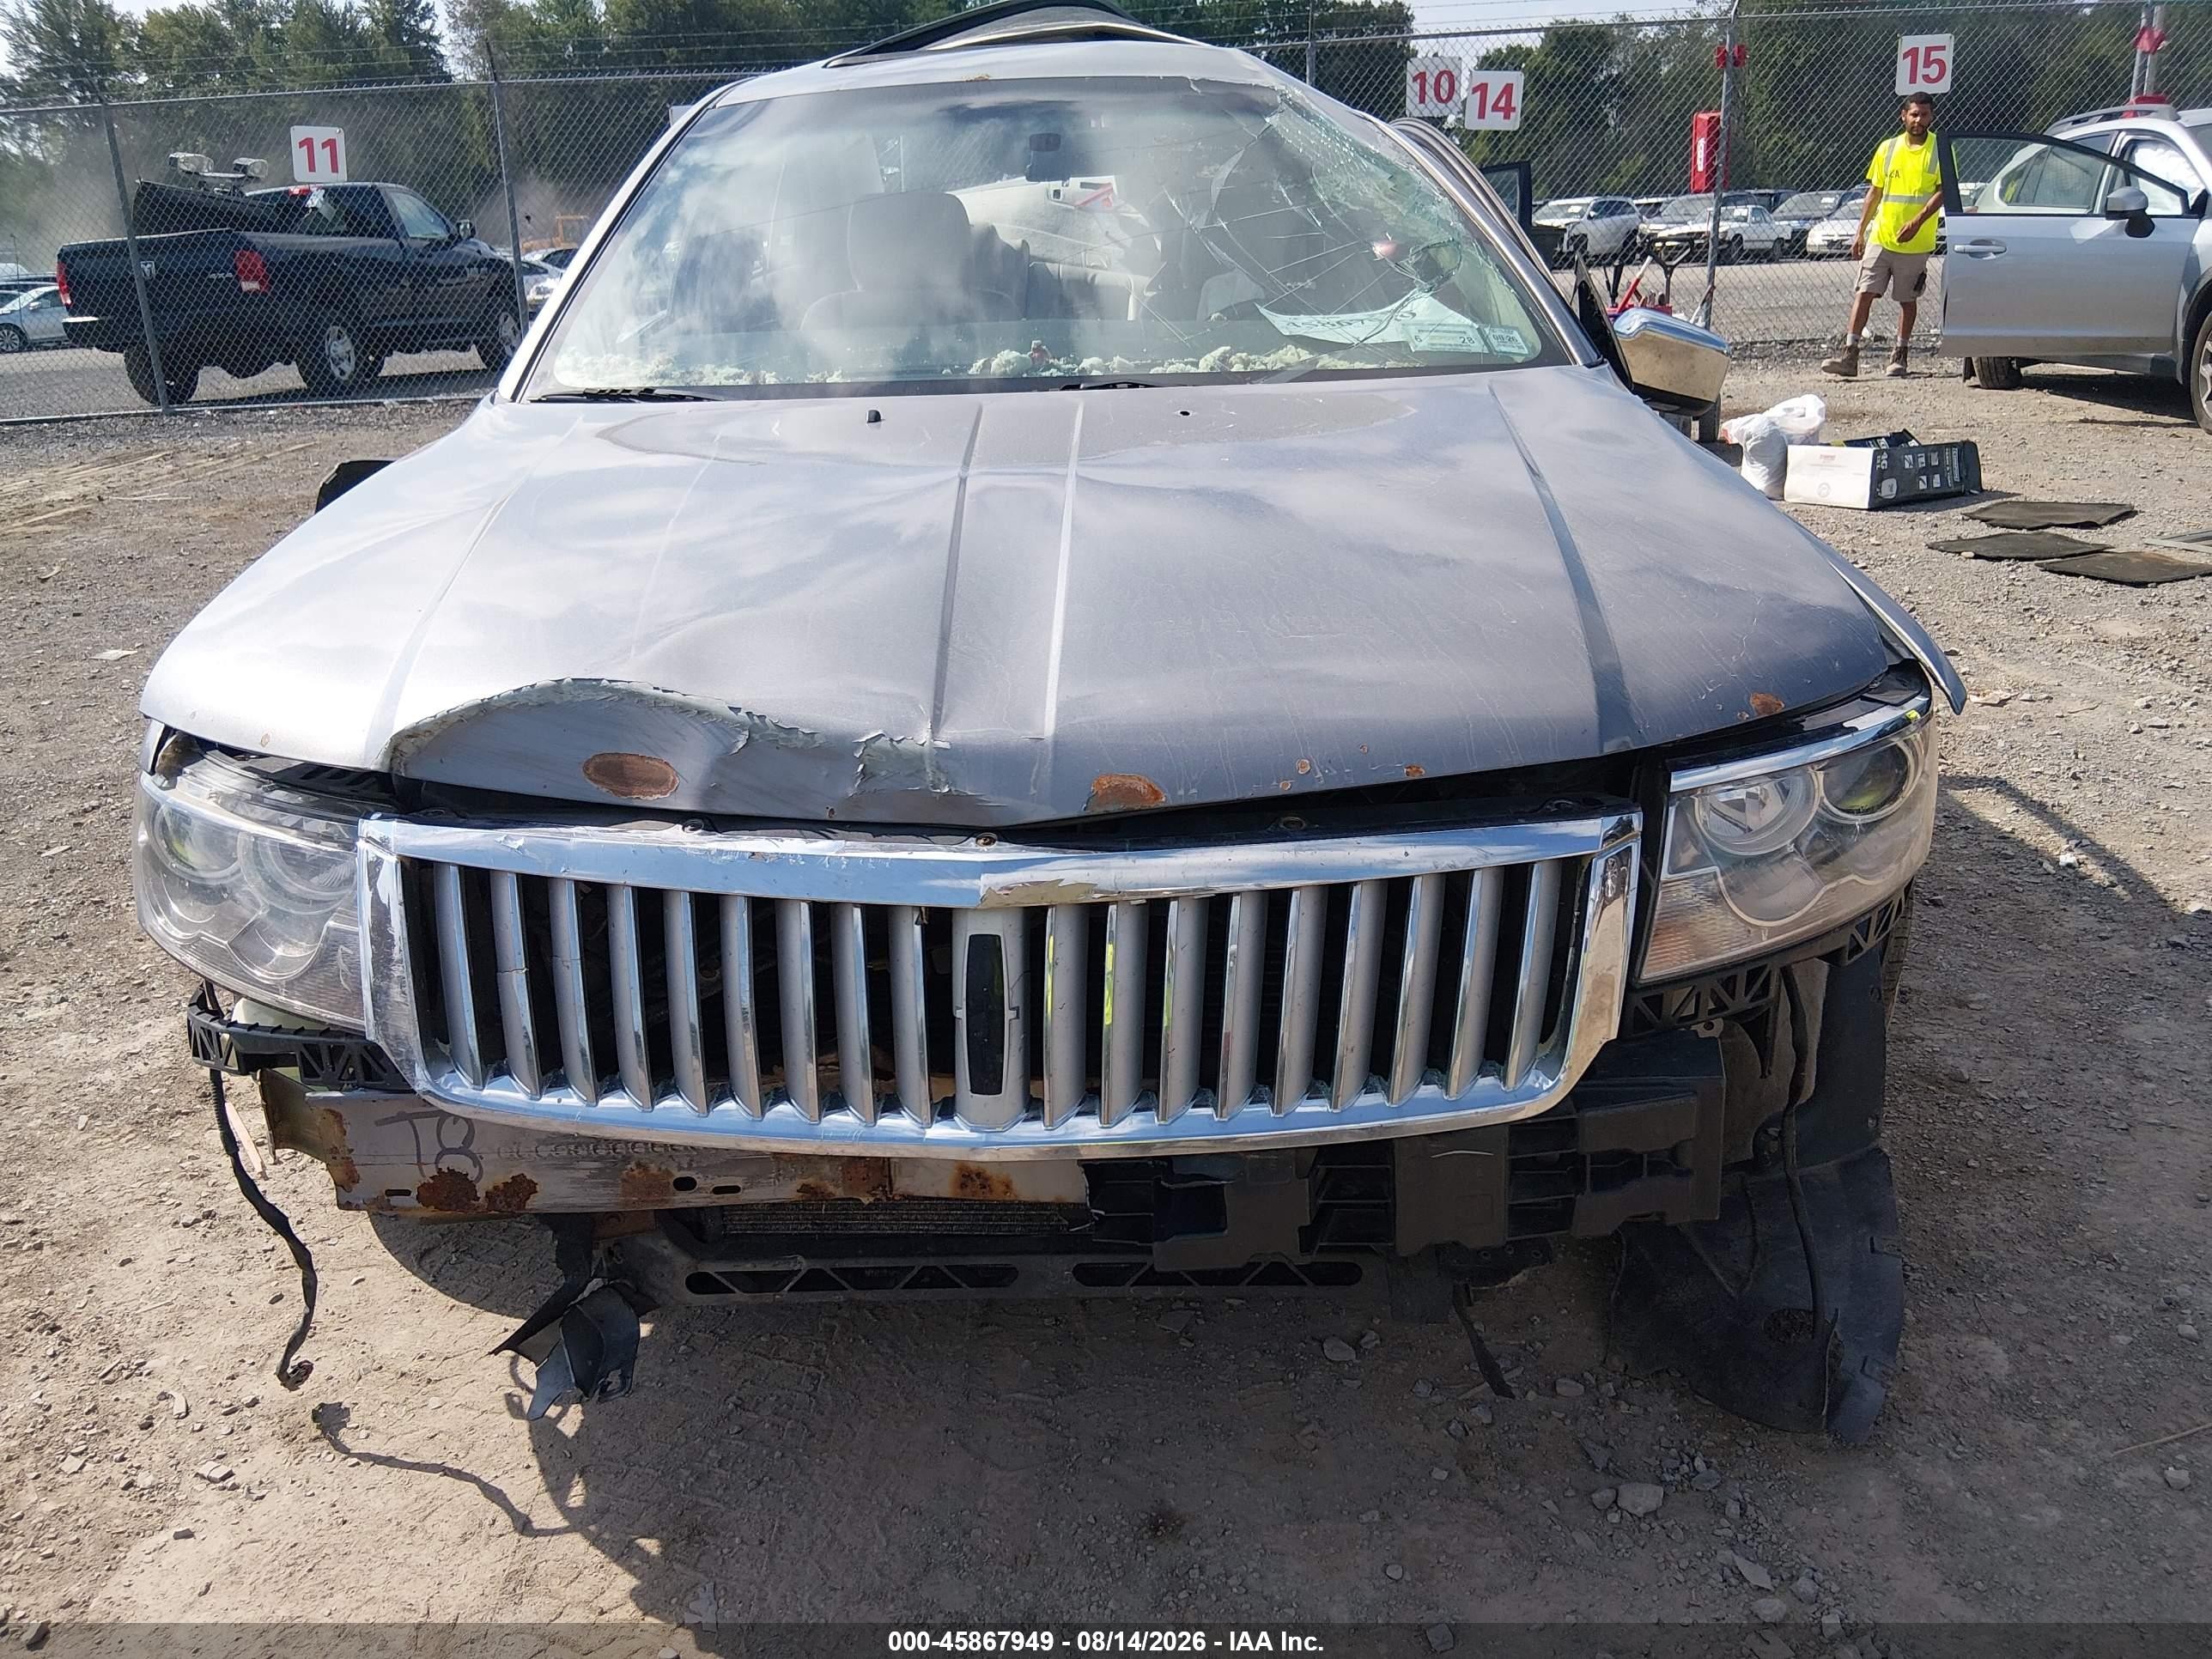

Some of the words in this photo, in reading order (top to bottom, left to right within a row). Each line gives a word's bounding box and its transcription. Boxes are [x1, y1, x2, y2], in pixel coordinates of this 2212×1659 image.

[1902, 46, 1947, 84] 15
[1413, 70, 1455, 105] 10
[1471, 83, 1516, 120] 14
[298, 137, 339, 173] 11
